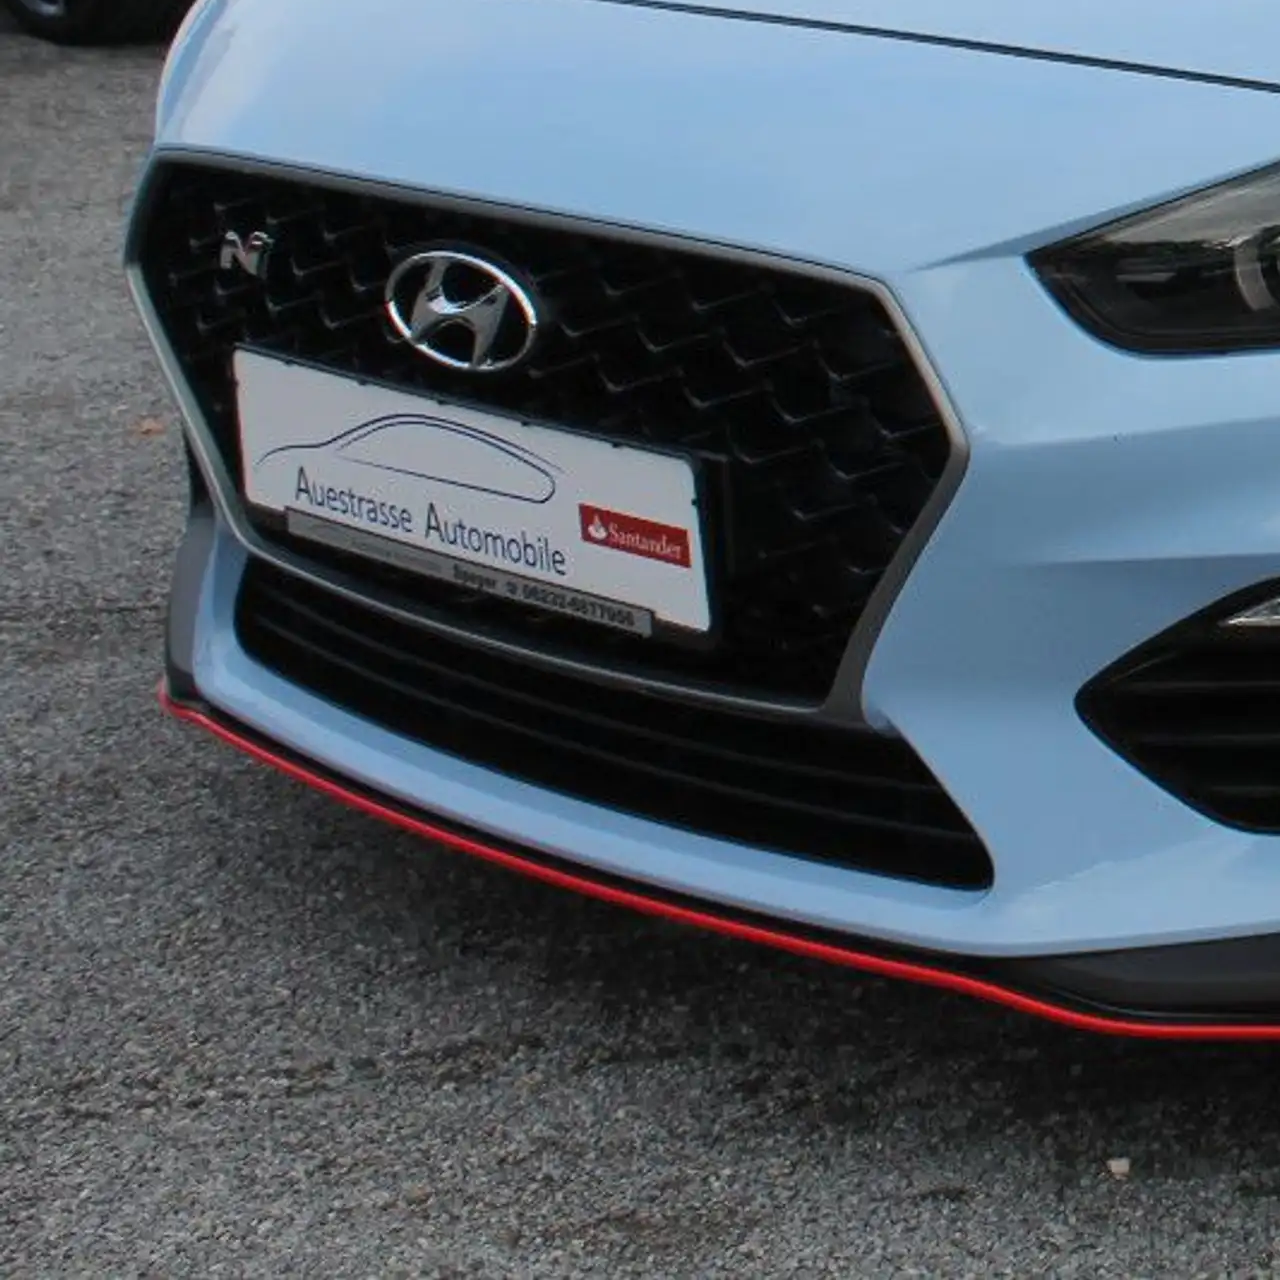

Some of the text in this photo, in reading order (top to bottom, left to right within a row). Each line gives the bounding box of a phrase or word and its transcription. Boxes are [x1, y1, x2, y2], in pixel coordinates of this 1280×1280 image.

[294, 466, 414, 533] Auestrasse
[425, 502, 567, 577] Automobile
[608, 521, 682, 559] Santander
